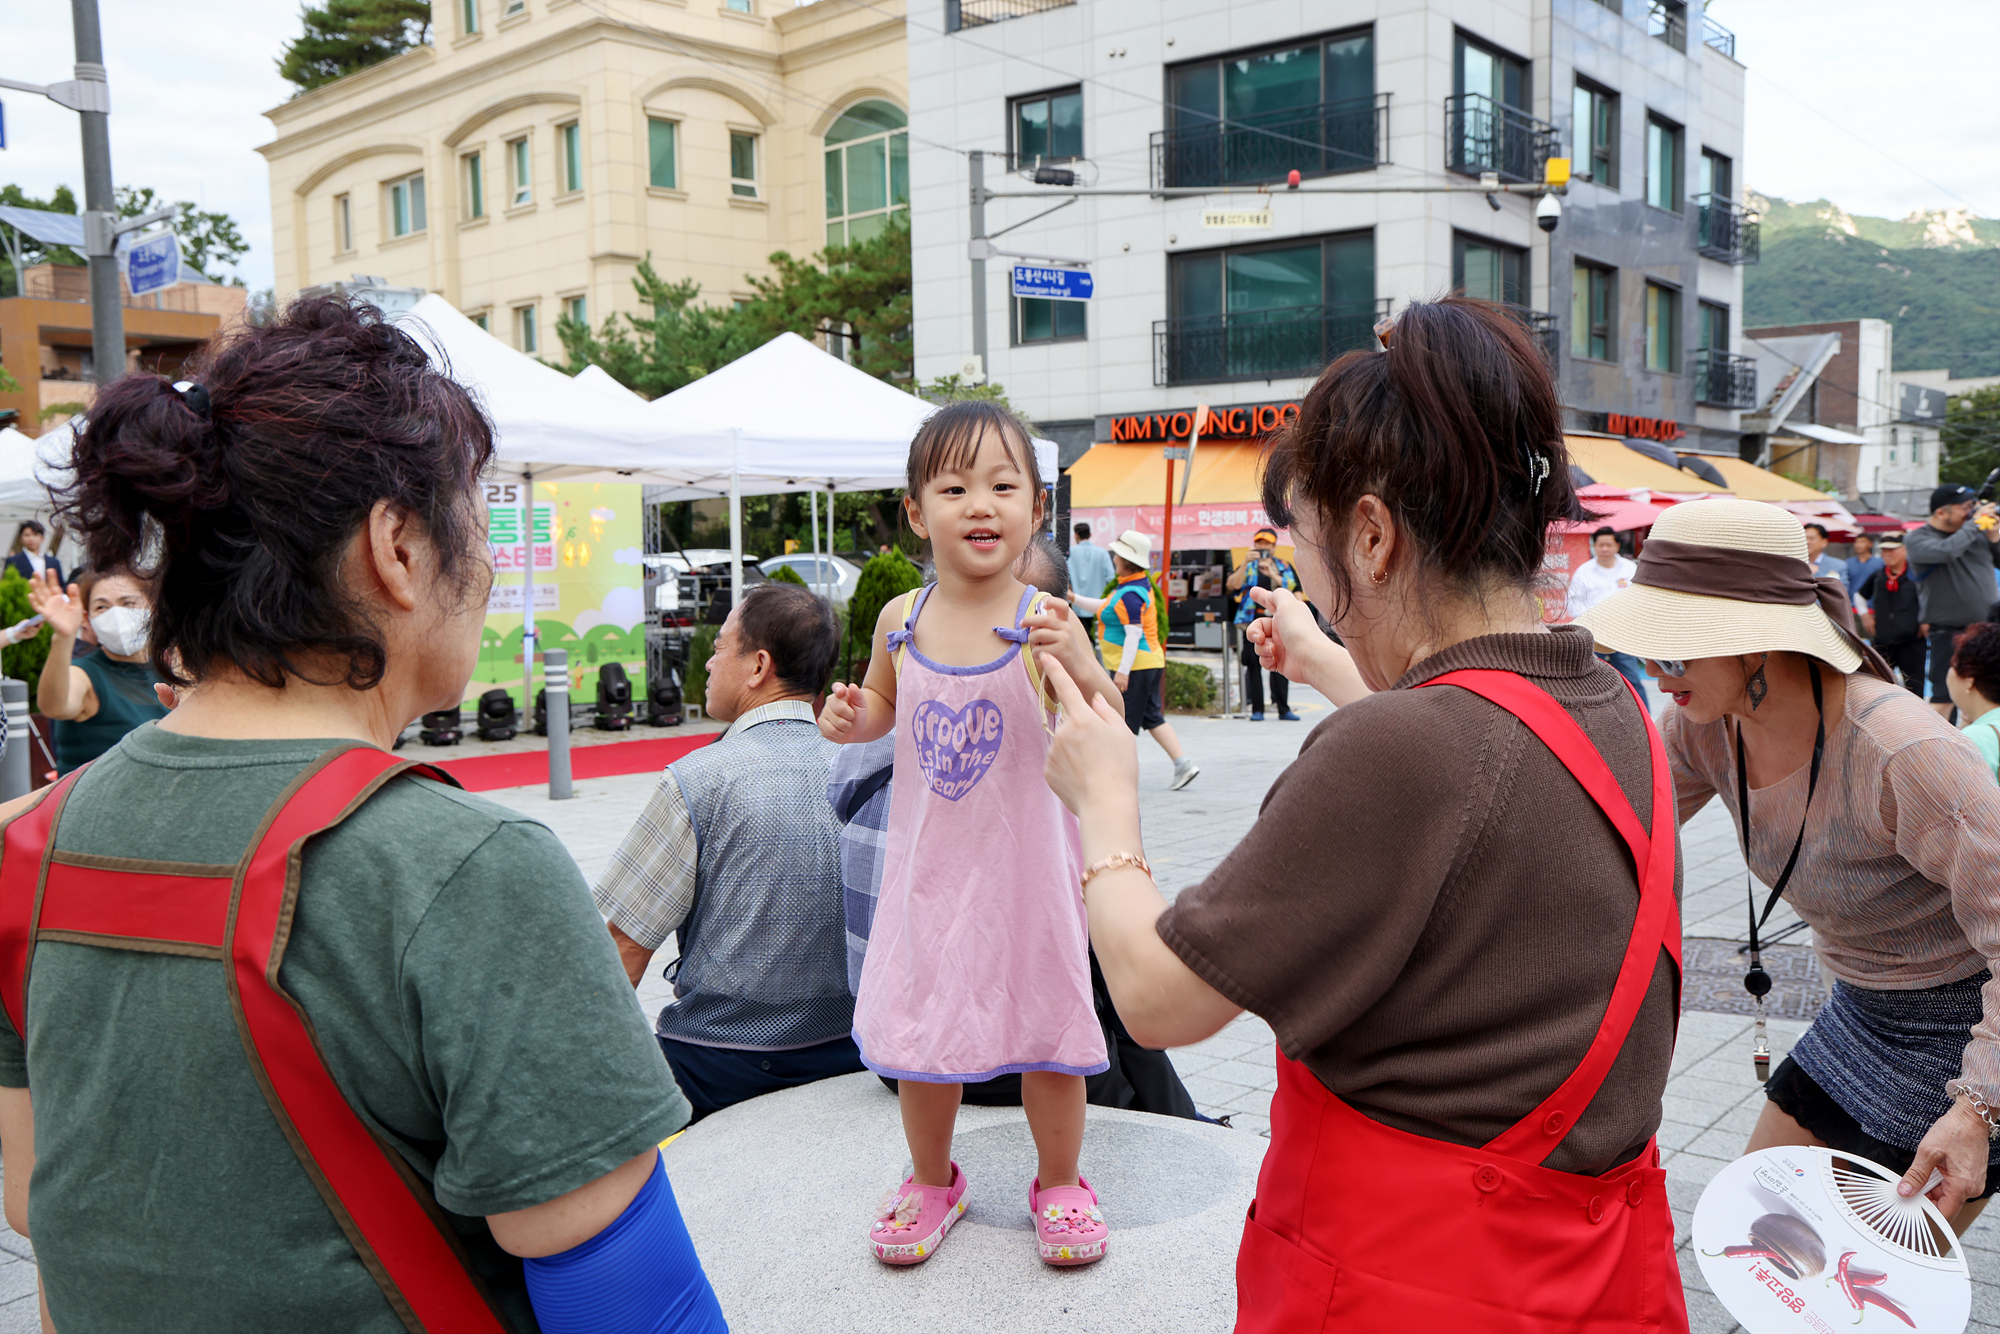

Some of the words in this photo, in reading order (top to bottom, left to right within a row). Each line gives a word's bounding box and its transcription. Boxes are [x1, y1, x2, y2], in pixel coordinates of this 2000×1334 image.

[1227, 215, 1247, 224] CCTV
[1111, 416, 1152, 440] KIM
[1250, 403, 1300, 436] JOO
[1198, 510, 1248, 527] 민생회복
[914, 703, 1000, 753] Groove
[959, 748, 996, 773] The
[1748, 1261, 1806, 1314] 영양고추!
